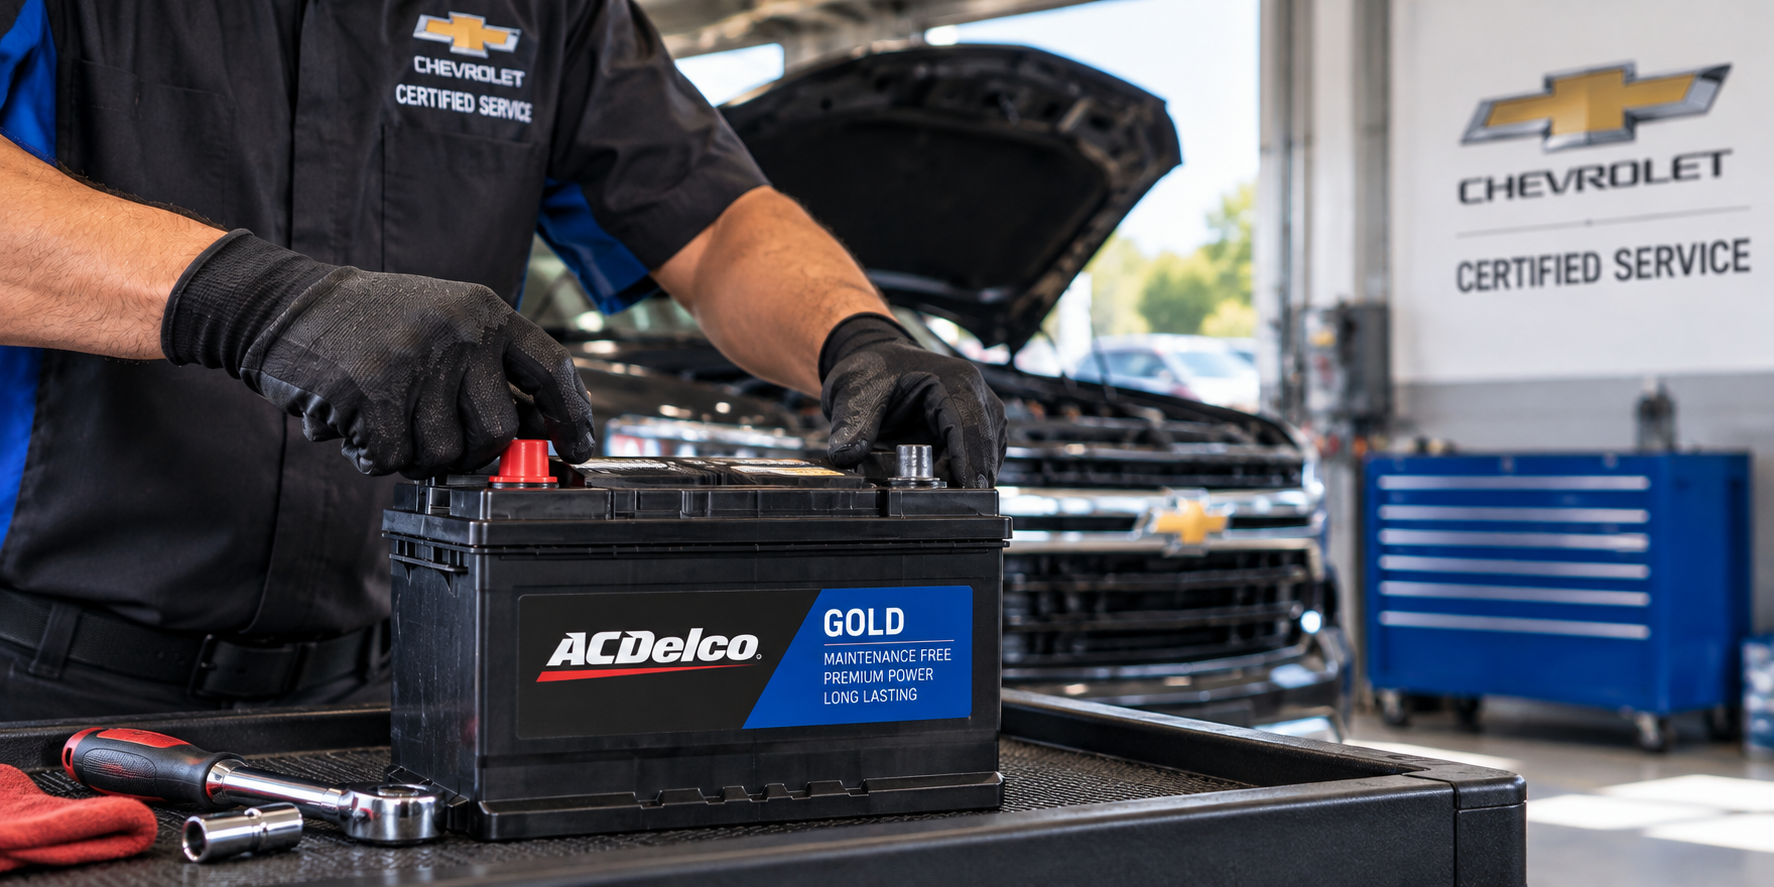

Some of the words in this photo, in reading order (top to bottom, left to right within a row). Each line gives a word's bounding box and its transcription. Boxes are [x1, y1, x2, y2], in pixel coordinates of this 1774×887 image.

[414, 55, 525, 88] CHEVROLET
[395, 84, 475, 113] CERTIFIED
[479, 95, 532, 123] SERVICE
[1458, 149, 1733, 204] CHEVROLET
[1456, 250, 1602, 294] CERTIFIED
[1614, 237, 1752, 282] SERVICE
[824, 607, 905, 638] GOLD
[546, 627, 759, 667] ACDelco
[824, 649, 916, 666] MAINTENANCE
[920, 647, 952, 662] FREE
[824, 669, 884, 685] PREMIUM
[888, 667, 934, 683] POWER
[824, 690, 859, 705] LONG
[863, 687, 918, 703] LASTING
